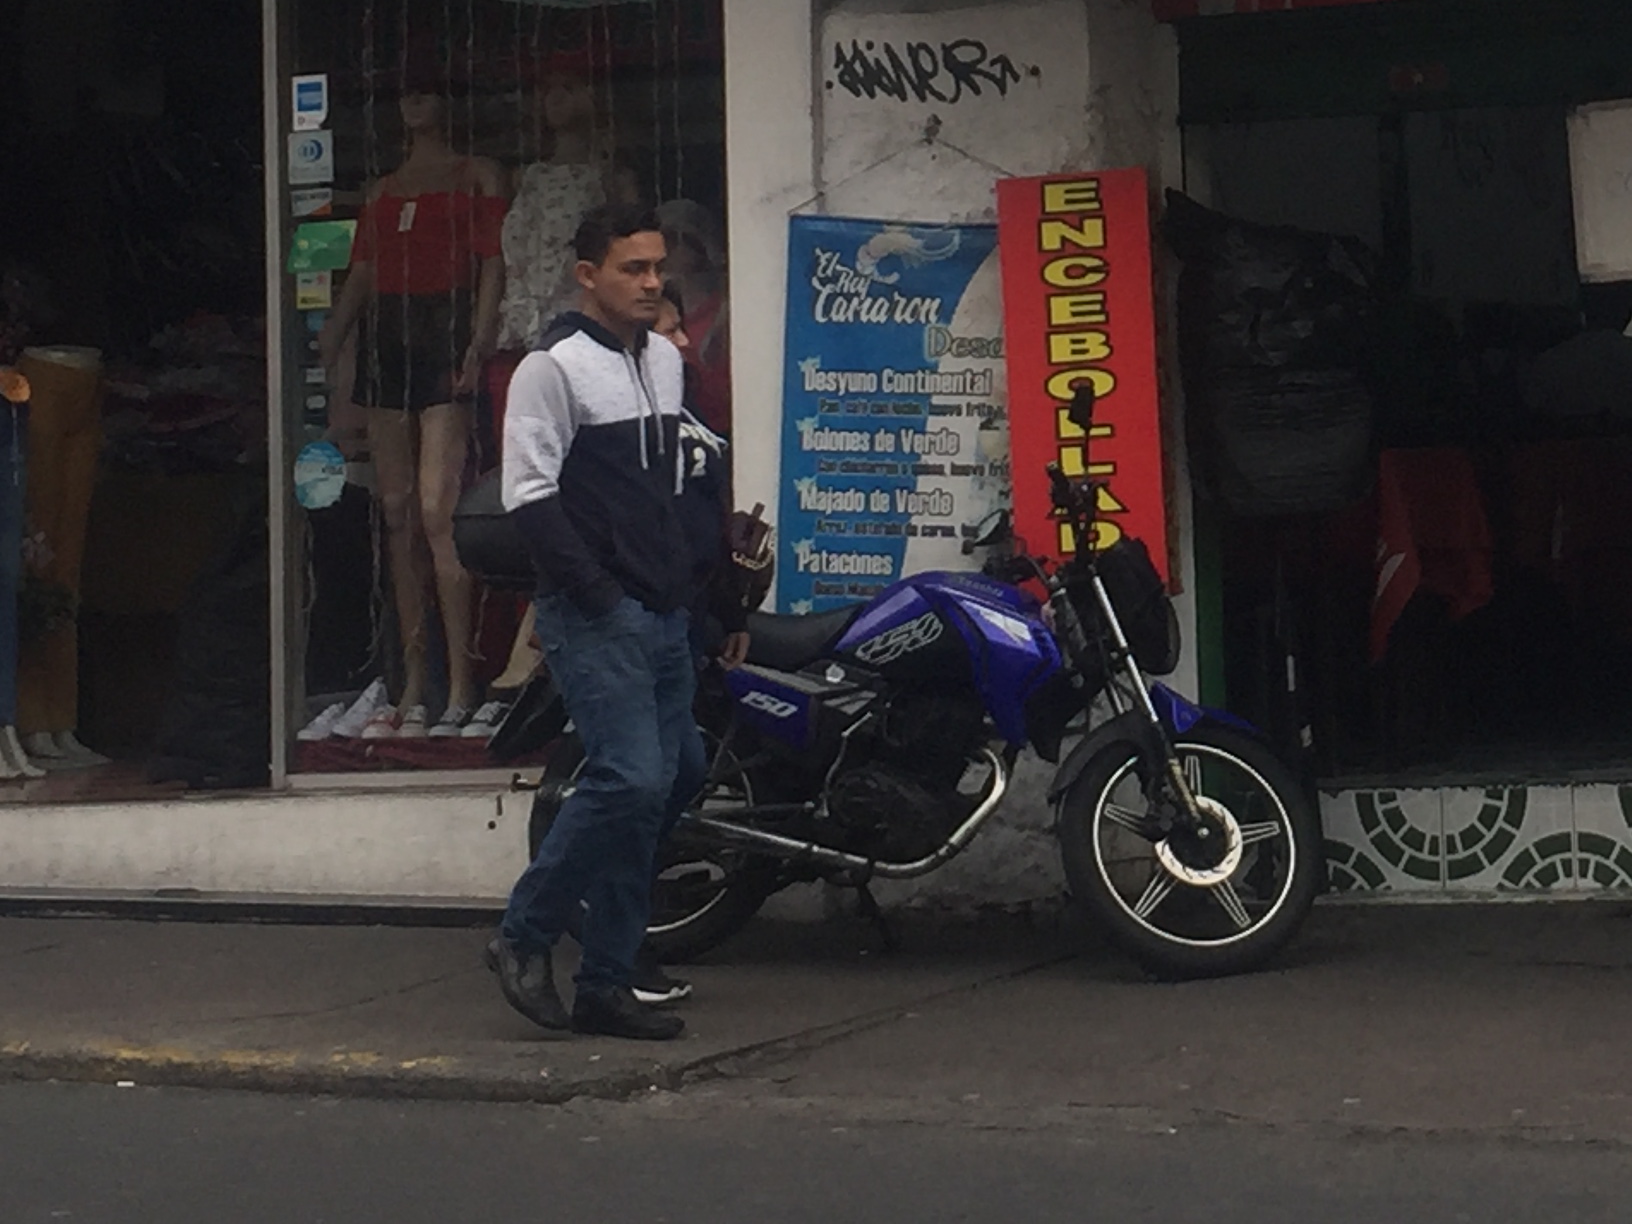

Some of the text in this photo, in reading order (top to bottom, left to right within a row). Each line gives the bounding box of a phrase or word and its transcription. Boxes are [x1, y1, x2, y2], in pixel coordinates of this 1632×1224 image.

[815, 247, 841, 277] El
[881, 368, 993, 395] Continental
[873, 427, 896, 453] de
[900, 426, 961, 456] Verde
[869, 488, 891, 512] de
[894, 487, 954, 516] Verde
